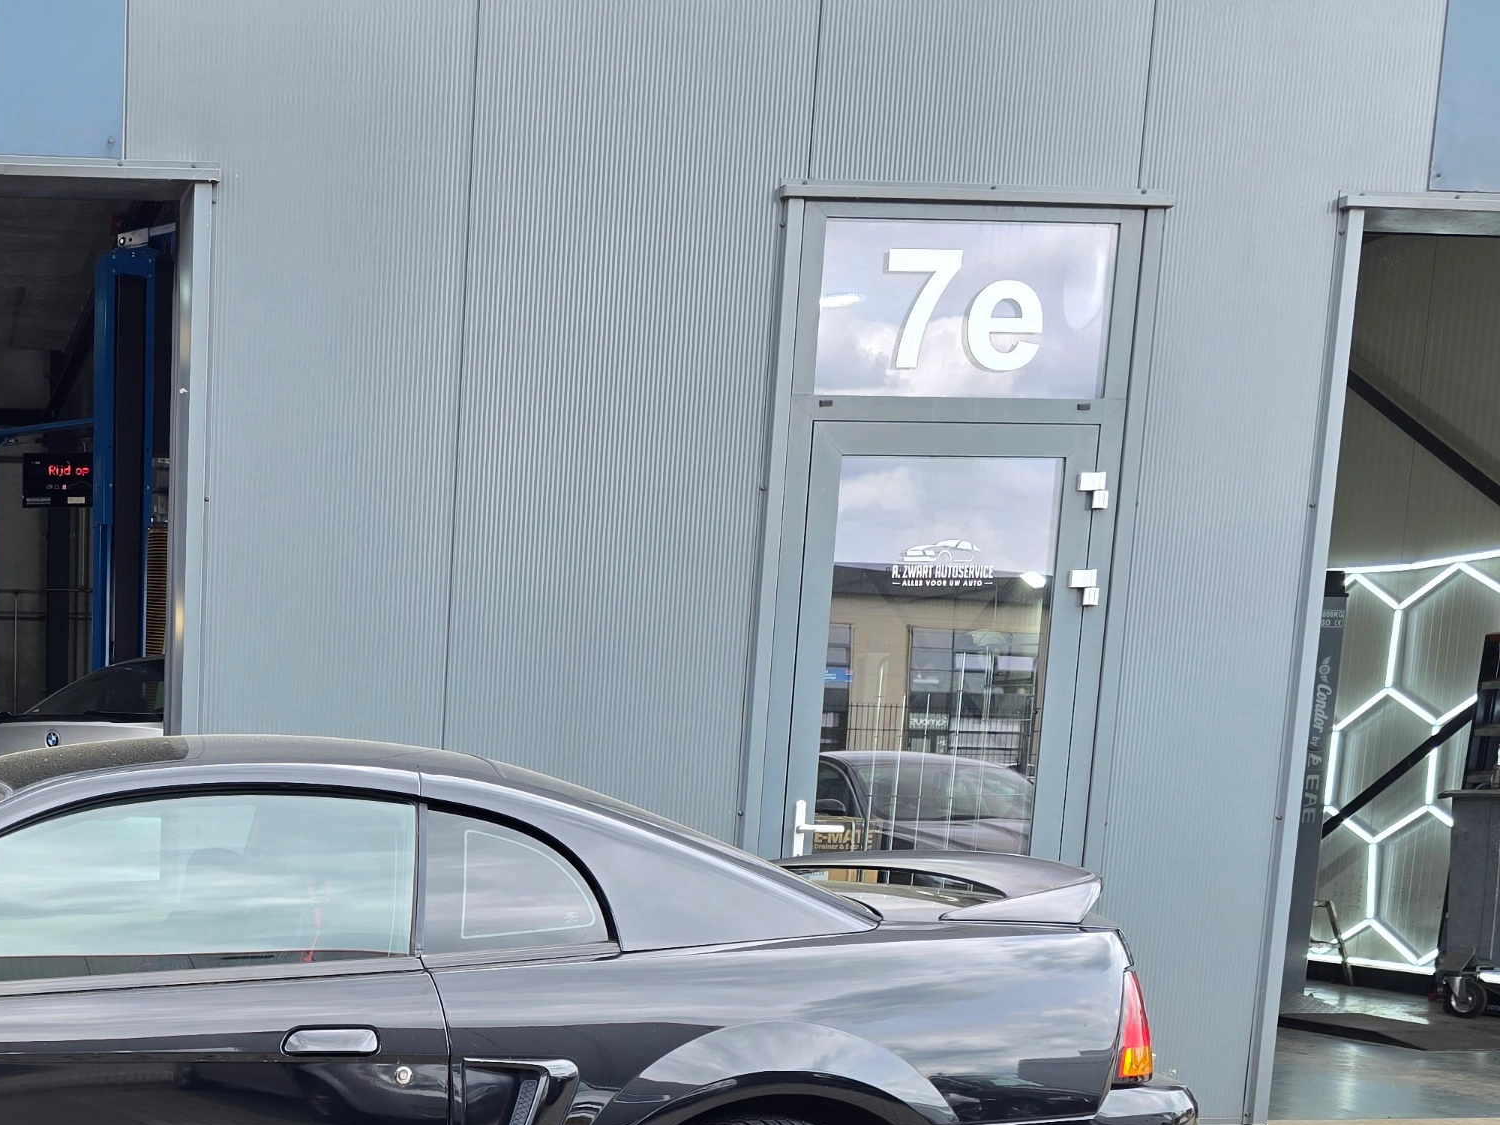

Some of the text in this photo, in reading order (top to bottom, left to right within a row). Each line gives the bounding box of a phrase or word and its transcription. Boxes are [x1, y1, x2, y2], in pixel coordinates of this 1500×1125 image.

[887, 248, 1043, 371] 7e
[892, 565, 994, 579] A. ZWART AUTOSERVICE
[1313, 683, 1332, 733] Condor
[1302, 774, 1320, 824] EAE
